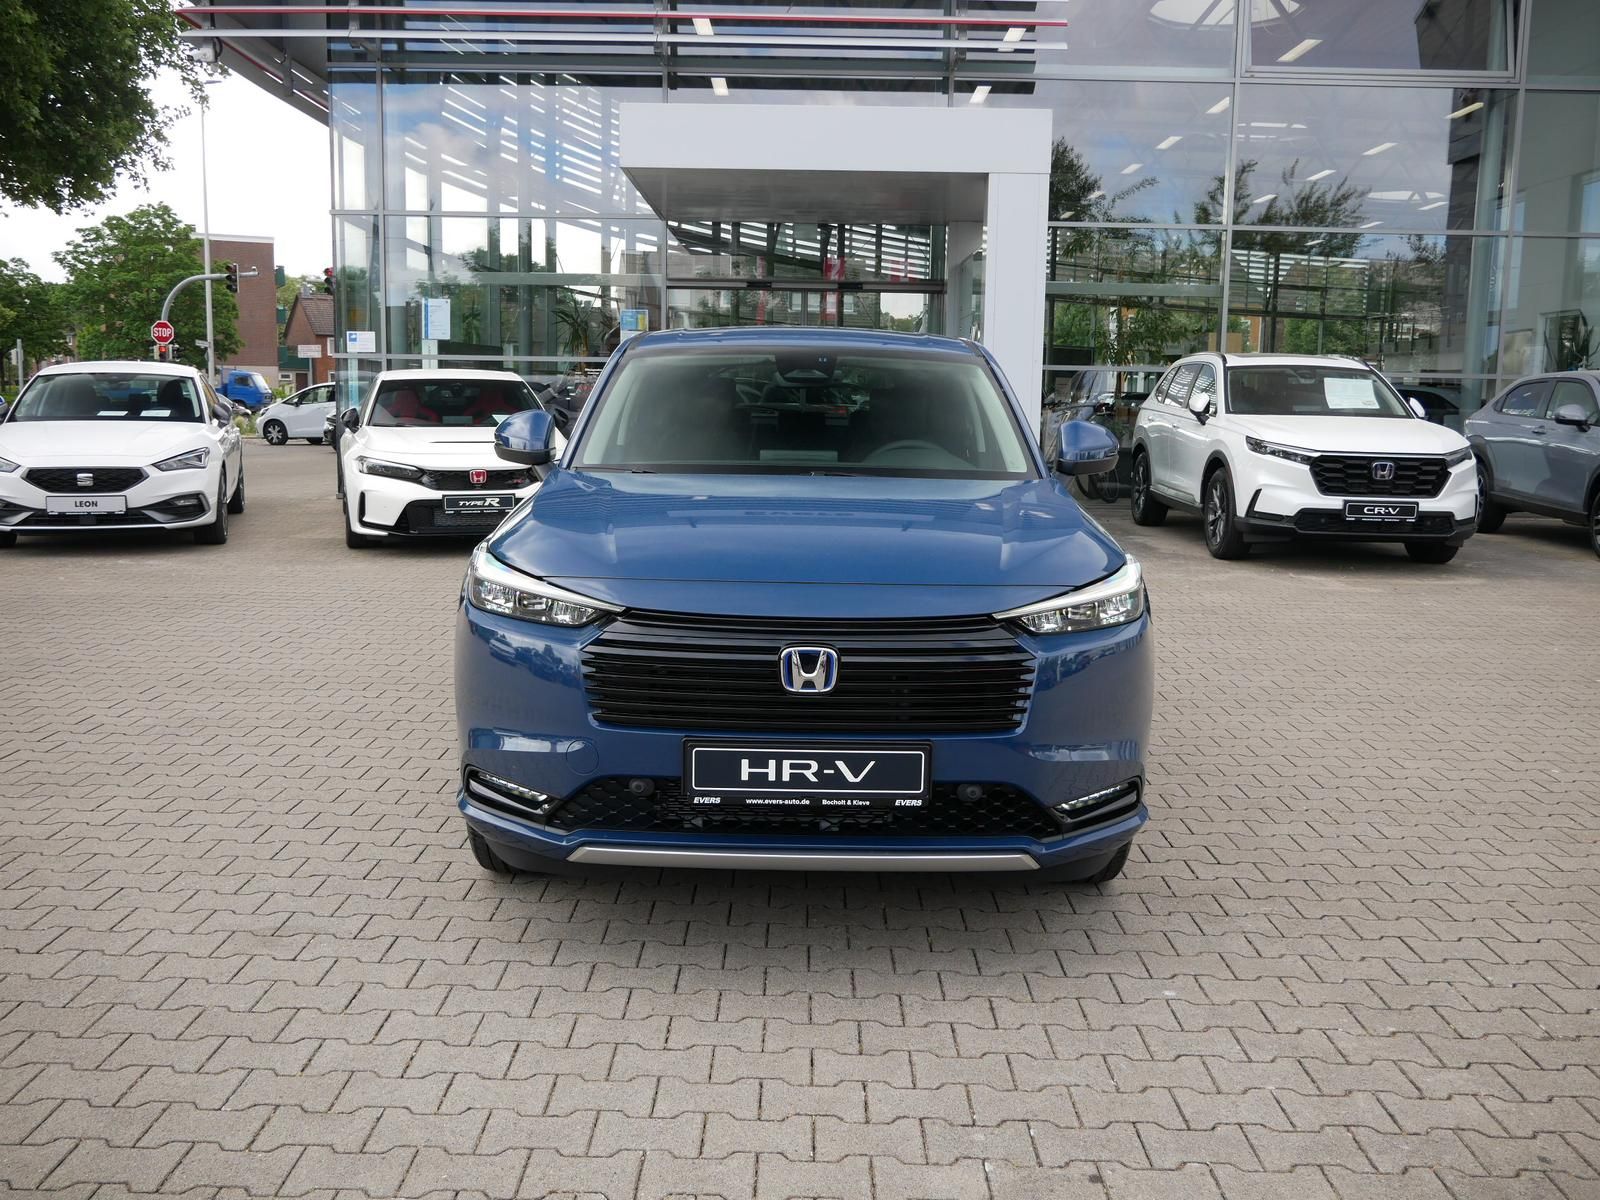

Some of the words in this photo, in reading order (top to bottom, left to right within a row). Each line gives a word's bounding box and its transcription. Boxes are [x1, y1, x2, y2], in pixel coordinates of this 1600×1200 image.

[153, 327, 172, 337] STOP
[74, 500, 98, 508] LEON
[1363, 506, 1400, 515] CR-V
[740, 758, 876, 783] HR-V
[693, 796, 721, 804] EVERS
[894, 799, 922, 807] EVERS
